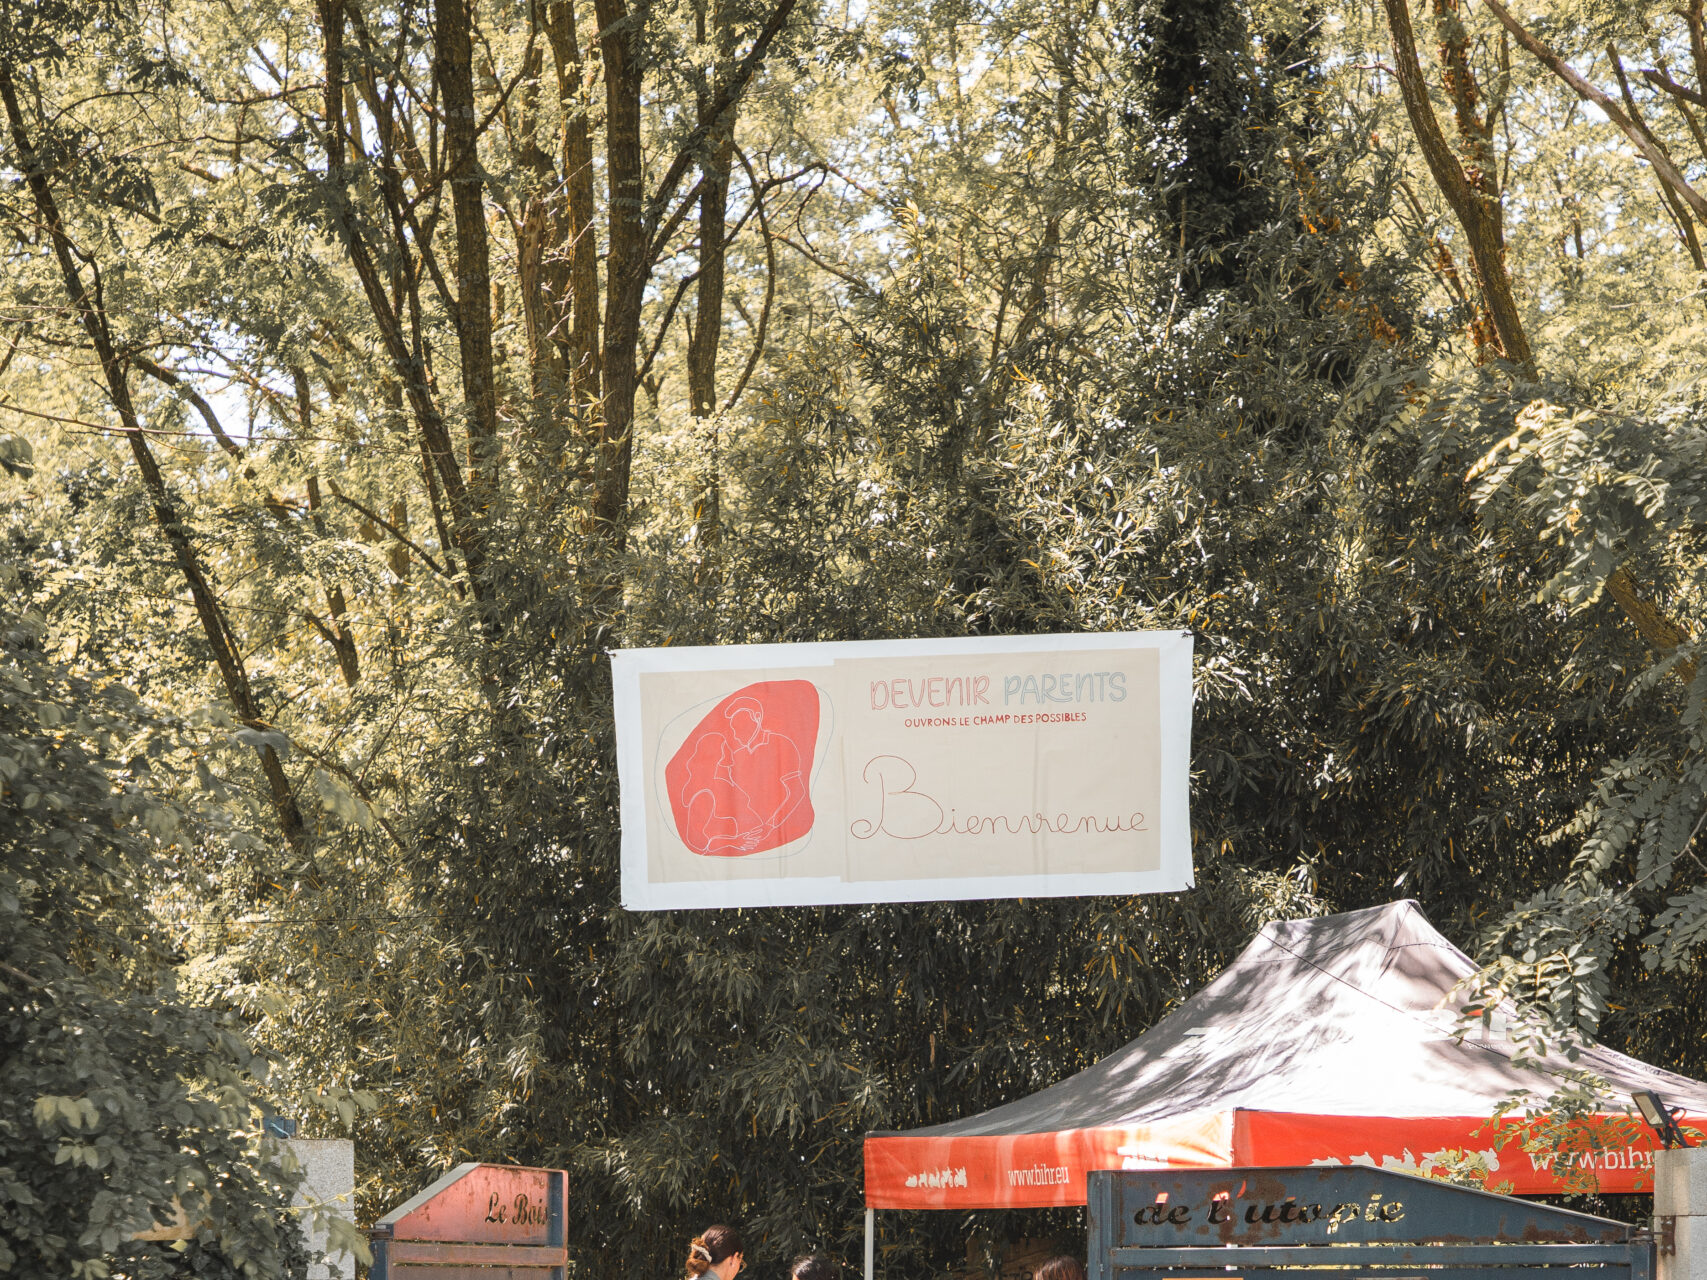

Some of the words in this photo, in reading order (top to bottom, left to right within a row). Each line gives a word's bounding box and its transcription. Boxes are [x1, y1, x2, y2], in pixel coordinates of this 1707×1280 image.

[870, 675, 990, 710] DEVENIR
[1004, 672, 1128, 705] PARENTS
[904, 717, 957, 728] OUVRONS
[959, 717, 970, 726] LE
[973, 714, 1011, 726] CHAMP
[1013, 714, 1034, 724] DES
[1035, 712, 1087, 723] POSSIBLES
[850, 755, 1149, 840] Bienvenue
[1008, 1164, 1070, 1187] www.bihr.eu
[485, 1192, 507, 1224] Le
[1134, 1192, 1192, 1226] de
